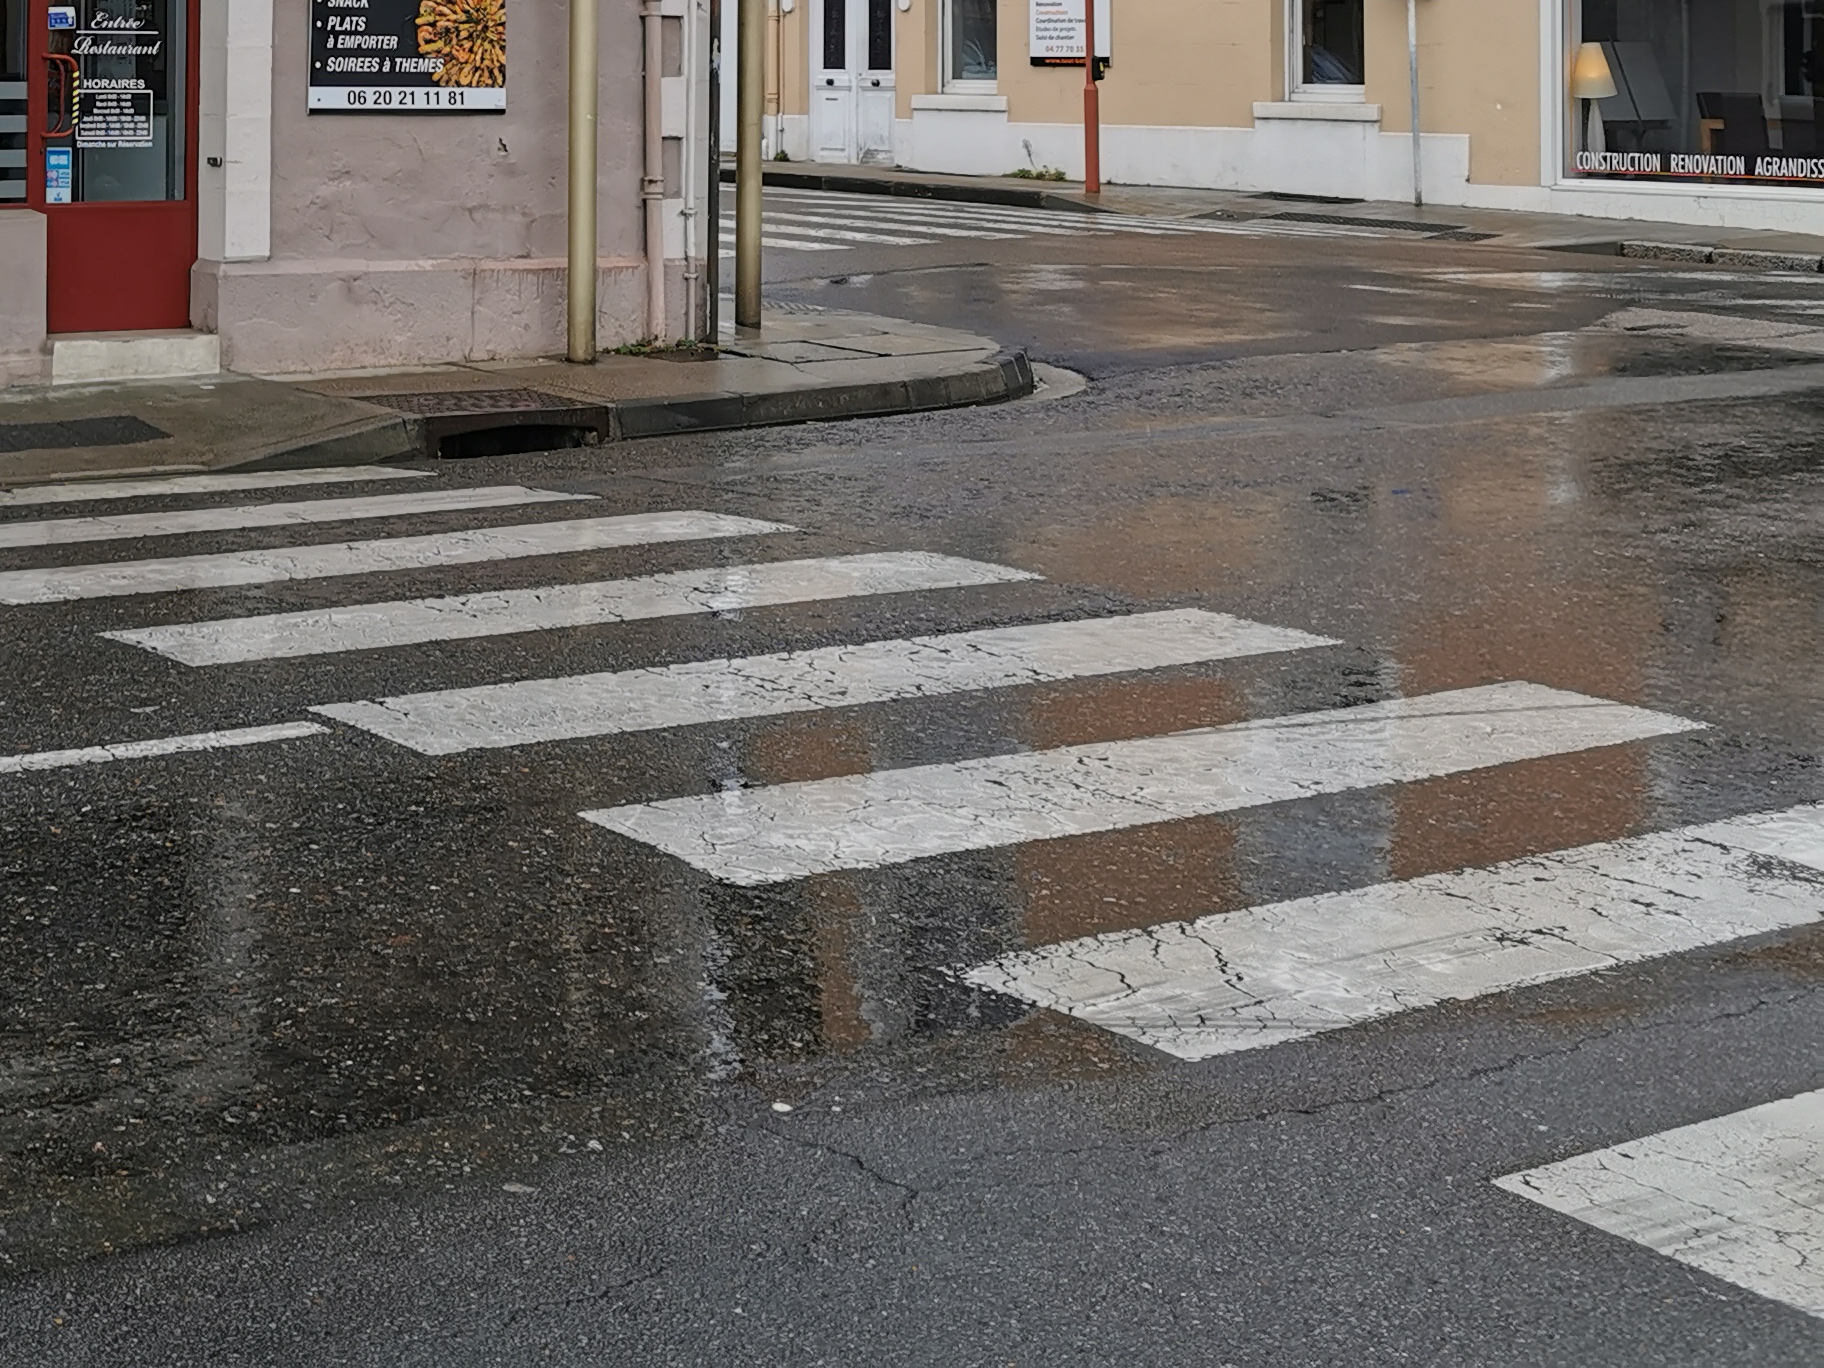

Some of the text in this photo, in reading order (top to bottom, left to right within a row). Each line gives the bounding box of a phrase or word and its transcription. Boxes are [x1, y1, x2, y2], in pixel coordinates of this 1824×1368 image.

[327, 16, 366, 31] PLATS
[71, 36, 163, 55] Restaurant
[327, 34, 398, 50] à EMPORTER
[326, 57, 445, 73] SOIREES à THEMES
[83, 79, 145, 89] HORAIRES
[347, 90, 465, 105] 06 20 21 11 81
[1576, 151, 1661, 172] CONSTRUCTION
[1670, 153, 1745, 175] RENOVATION
